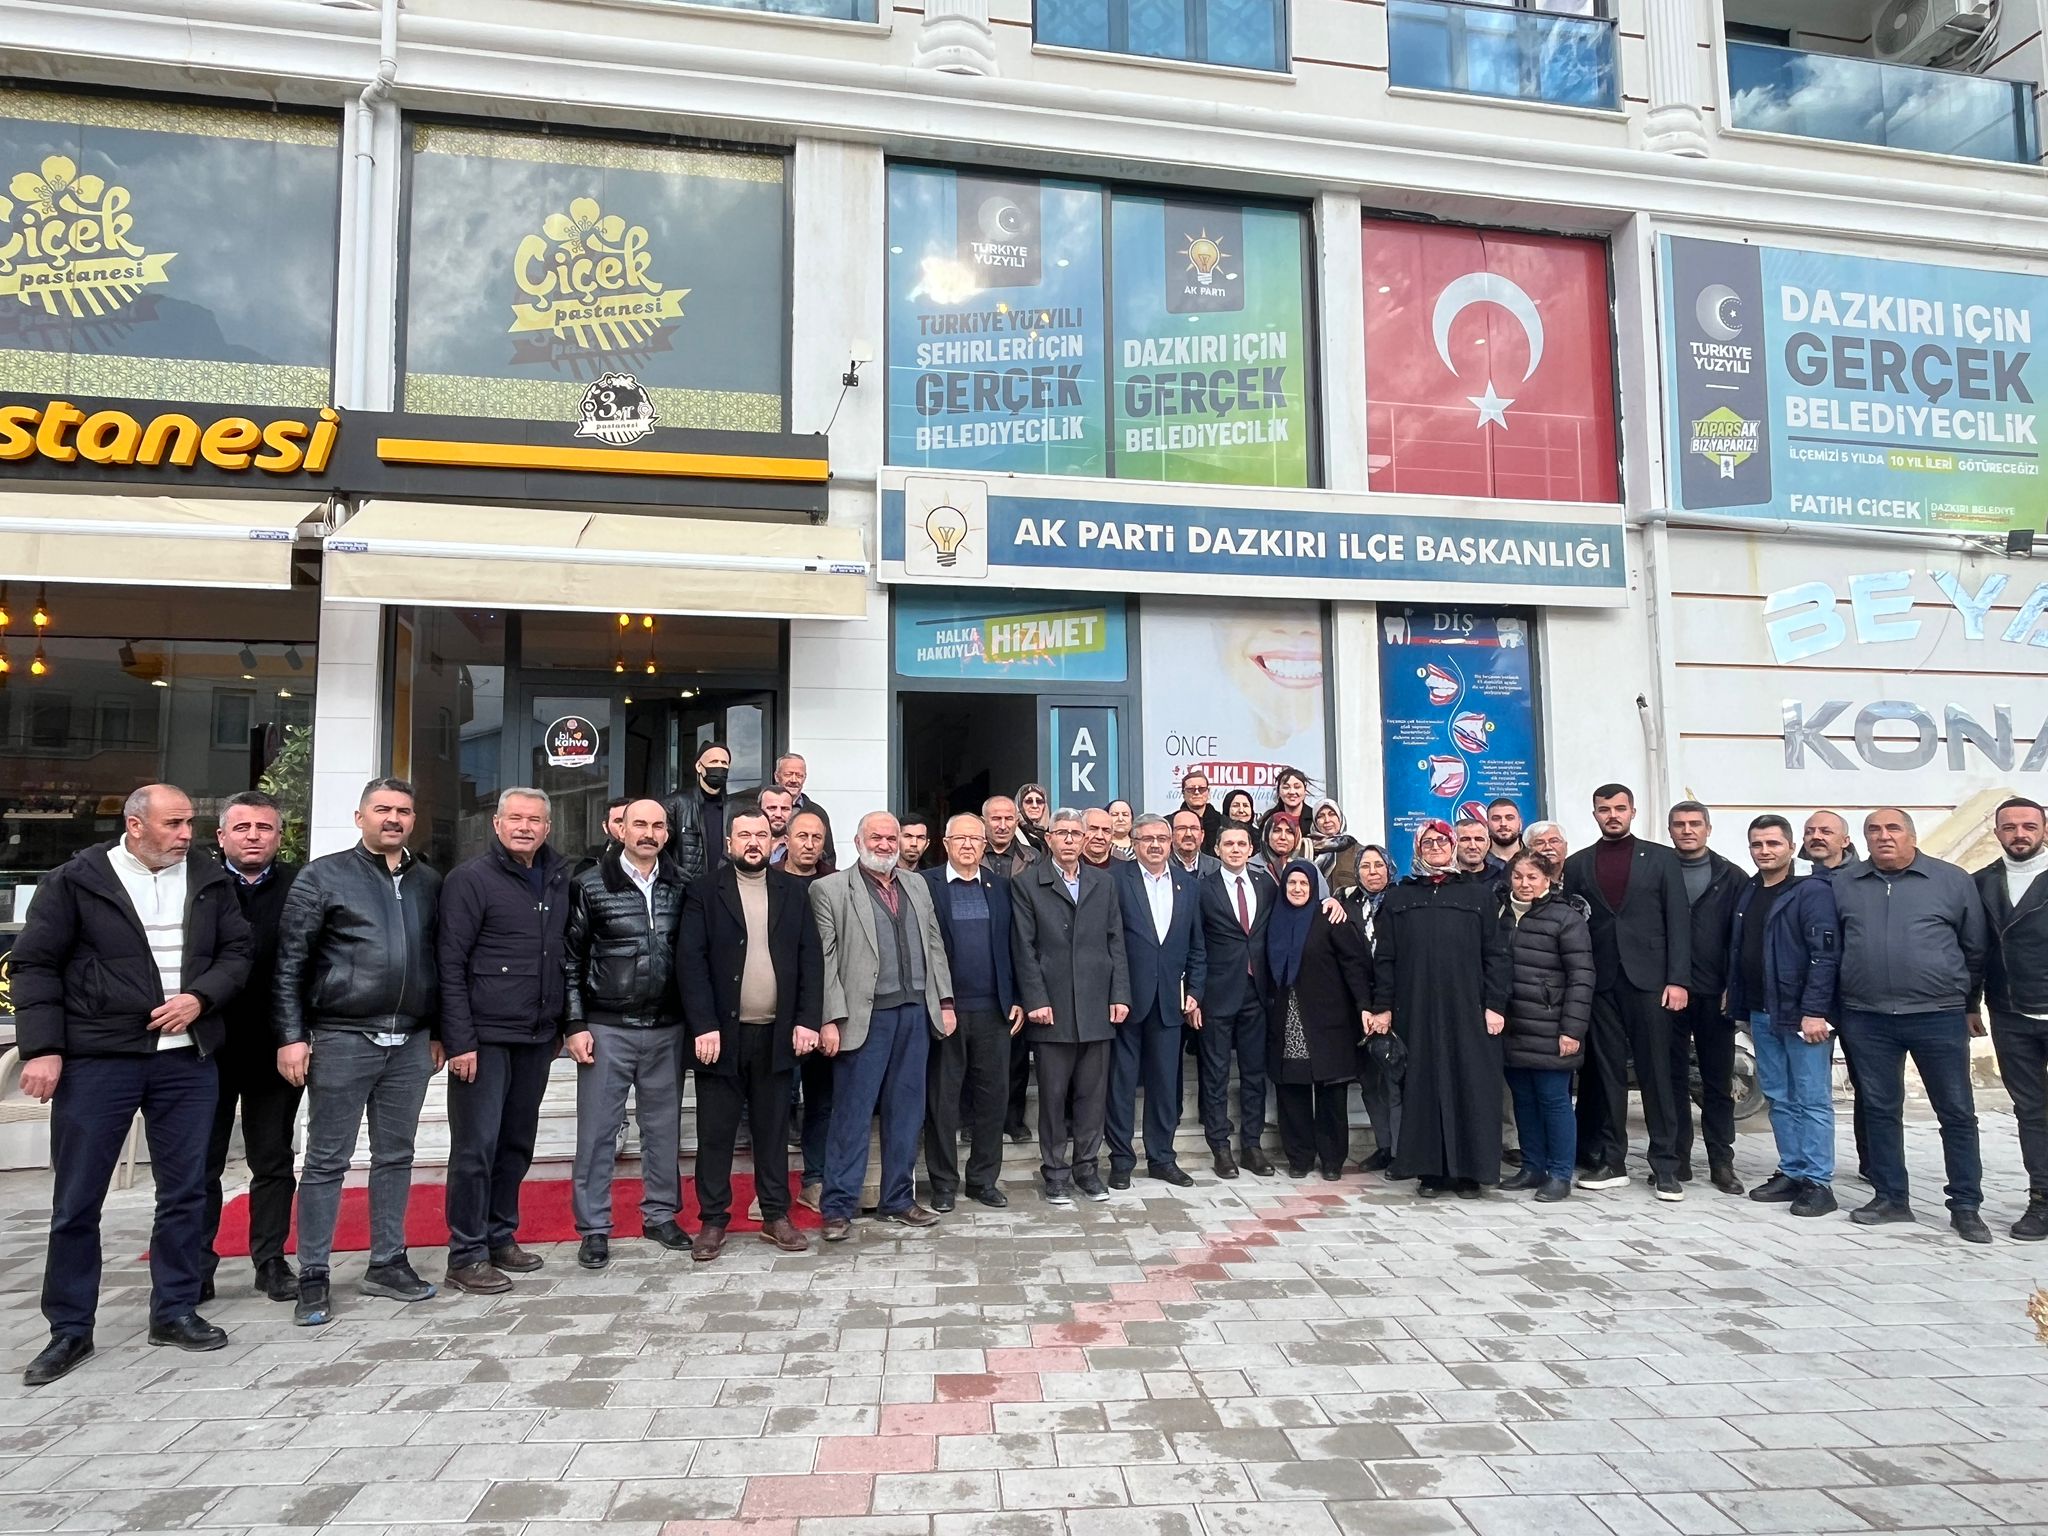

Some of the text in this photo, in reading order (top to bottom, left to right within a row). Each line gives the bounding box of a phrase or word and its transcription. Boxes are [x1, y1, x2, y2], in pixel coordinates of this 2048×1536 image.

[19, 262, 146, 292] pastanesi
[514, 226, 663, 309] Çiçek
[1184, 285, 1198, 295] AK
[555, 298, 663, 326] pastanesi
[1781, 286, 2031, 345] DAZKIRI İÇİN
[916, 334, 1083, 369] ŞEHİRLERİ İÇİN
[1124, 331, 1287, 373] DAZKIRI İÇİN
[1785, 332, 2034, 405] GERÇEK
[915, 364, 1084, 417] GERÇEK
[1125, 366, 1288, 419] GERÇEK
[0, 400, 343, 473] stanesi
[916, 416, 1084, 452] BELEDİYECİLİK
[1125, 418, 1288, 453] BELEDİYECİLİK
[1693, 421, 1758, 438] YAPARSAK
[1786, 396, 2038, 445] BELEDİYECİLİK
[1841, 452, 1849, 463] 5
[1851, 453, 1885, 465] YILDA
[1890, 455, 1904, 467] 10
[1907, 457, 1924, 469] YIL
[1926, 456, 1953, 470] İLERİ
[1931, 502, 1969, 513] DAZKIRI
[1014, 518, 1611, 568] AK PARTİ DAZKIRI İLÇE BAŞKANLIĞI
[936, 627, 978, 645] HALKA
[991, 615, 1098, 655] HİZMET
[1433, 608, 1474, 637] DİŞ
[917, 642, 980, 662] HAKKIYLA
[1165, 730, 1219, 757] ÖNCE
